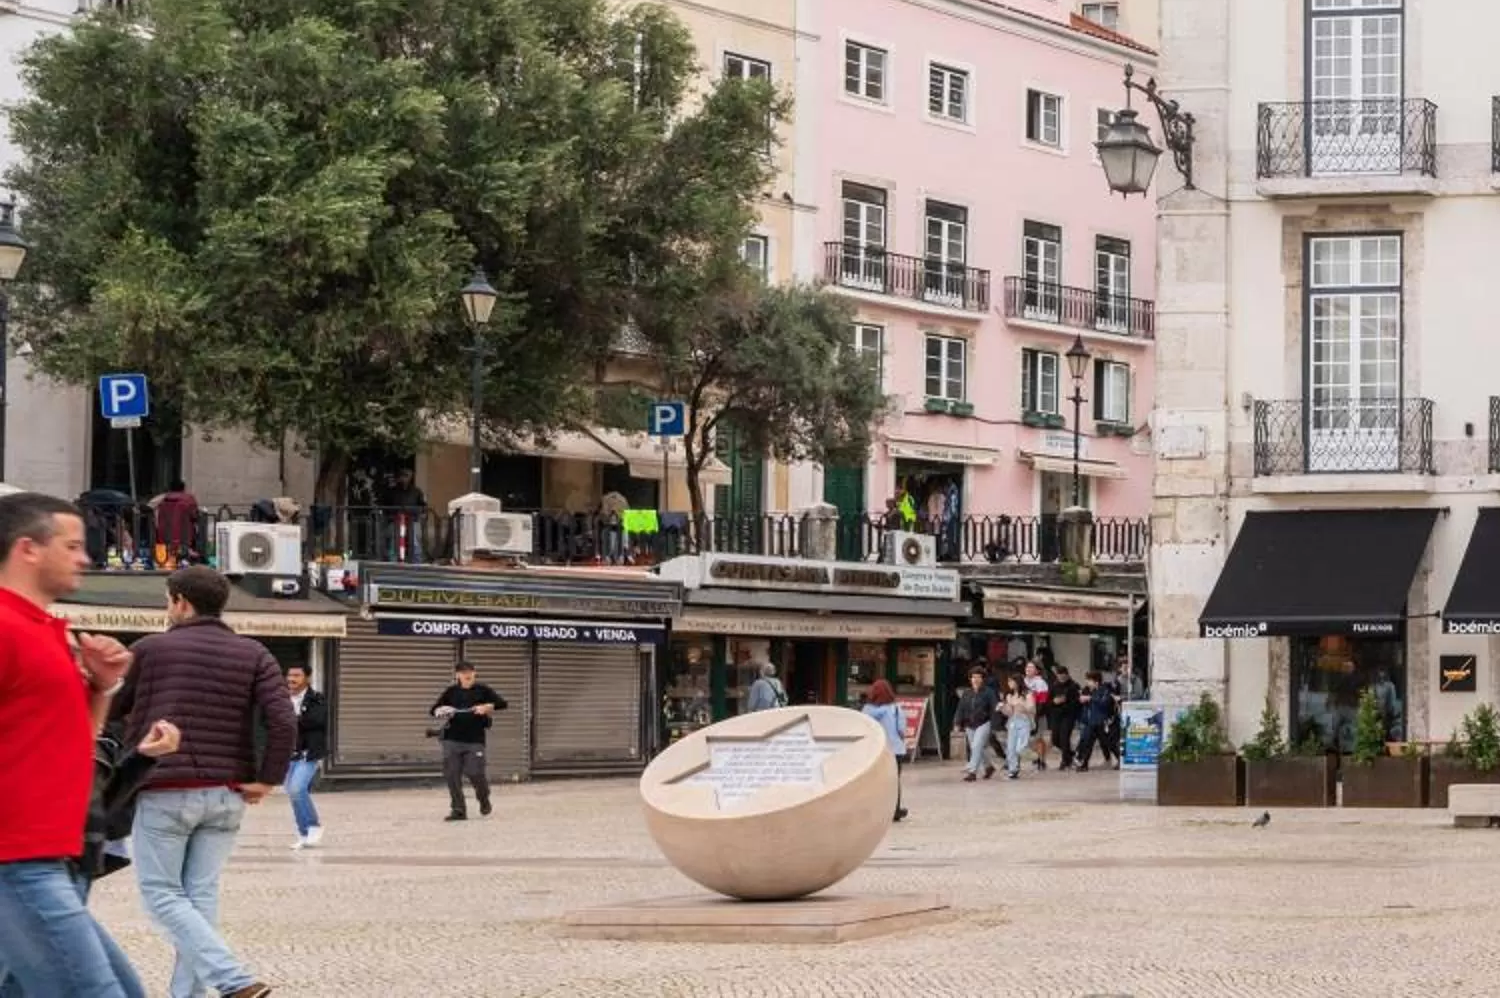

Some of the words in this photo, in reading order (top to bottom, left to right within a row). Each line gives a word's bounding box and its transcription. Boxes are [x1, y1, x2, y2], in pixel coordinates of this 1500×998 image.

[110, 379, 136, 413] P
[655, 405, 677, 433] P
[412, 621, 470, 636] COMPRA
[490, 624, 528, 639] OURO
[534, 625, 577, 640] USADO
[595, 628, 637, 642] VENDA
[1205, 623, 1259, 637] boémio
